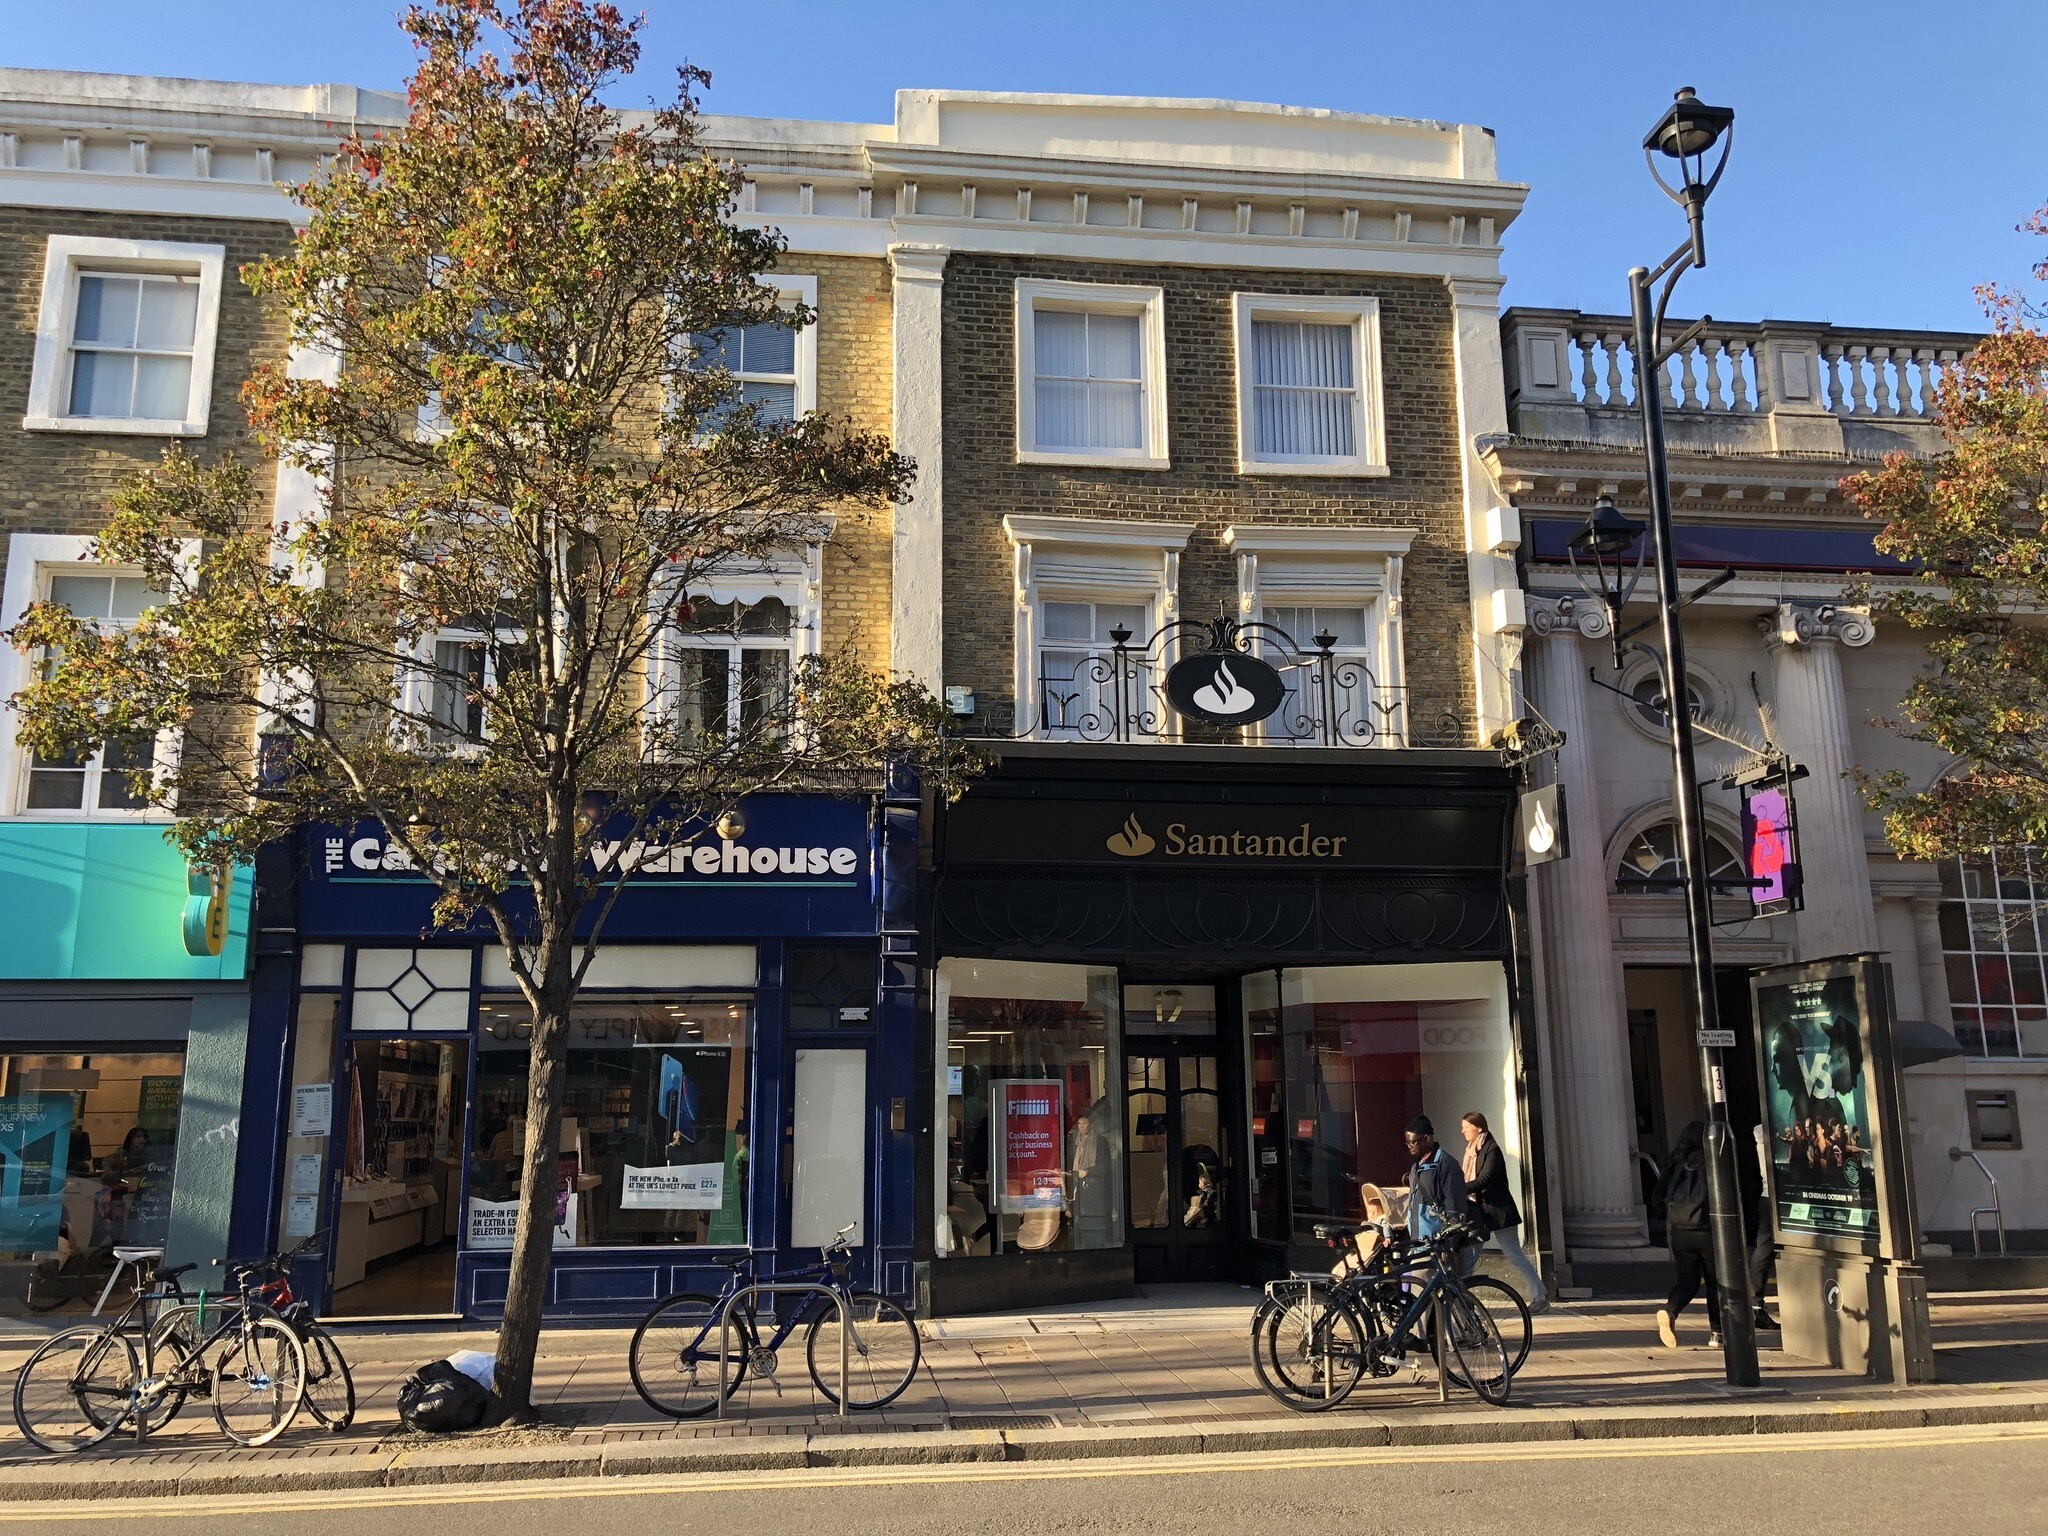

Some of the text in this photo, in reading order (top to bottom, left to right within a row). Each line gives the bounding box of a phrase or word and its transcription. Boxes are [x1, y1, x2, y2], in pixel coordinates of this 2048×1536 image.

[1165, 822, 1347, 857] Santander
[325, 838, 344, 873] THE
[589, 840, 858, 875] Warehouse
[1155, 989, 1184, 1022] 17
[19, 1103, 45, 1113] BEST
[22, 1112, 48, 1122] NEW
[0, 1123, 14, 1132] XS
[1009, 1131, 1040, 1140] Cashback
[1008, 1140, 1053, 1151] your business
[1008, 1150, 1038, 1159] account.
[628, 1182, 635, 1190] AT
[680, 1183, 697, 1191] PRICE
[1808, 1192, 1827, 1200] CINEMAS
[1827, 1193, 1847, 1202] OCTOBER
[1846, 1194, 1853, 1203] 19
[473, 1209, 505, 1219] TRADE-IN
[472, 1218, 483, 1228] AN
[484, 1218, 506, 1227] EXTRA
[472, 1227, 506, 1236] SELECTED
